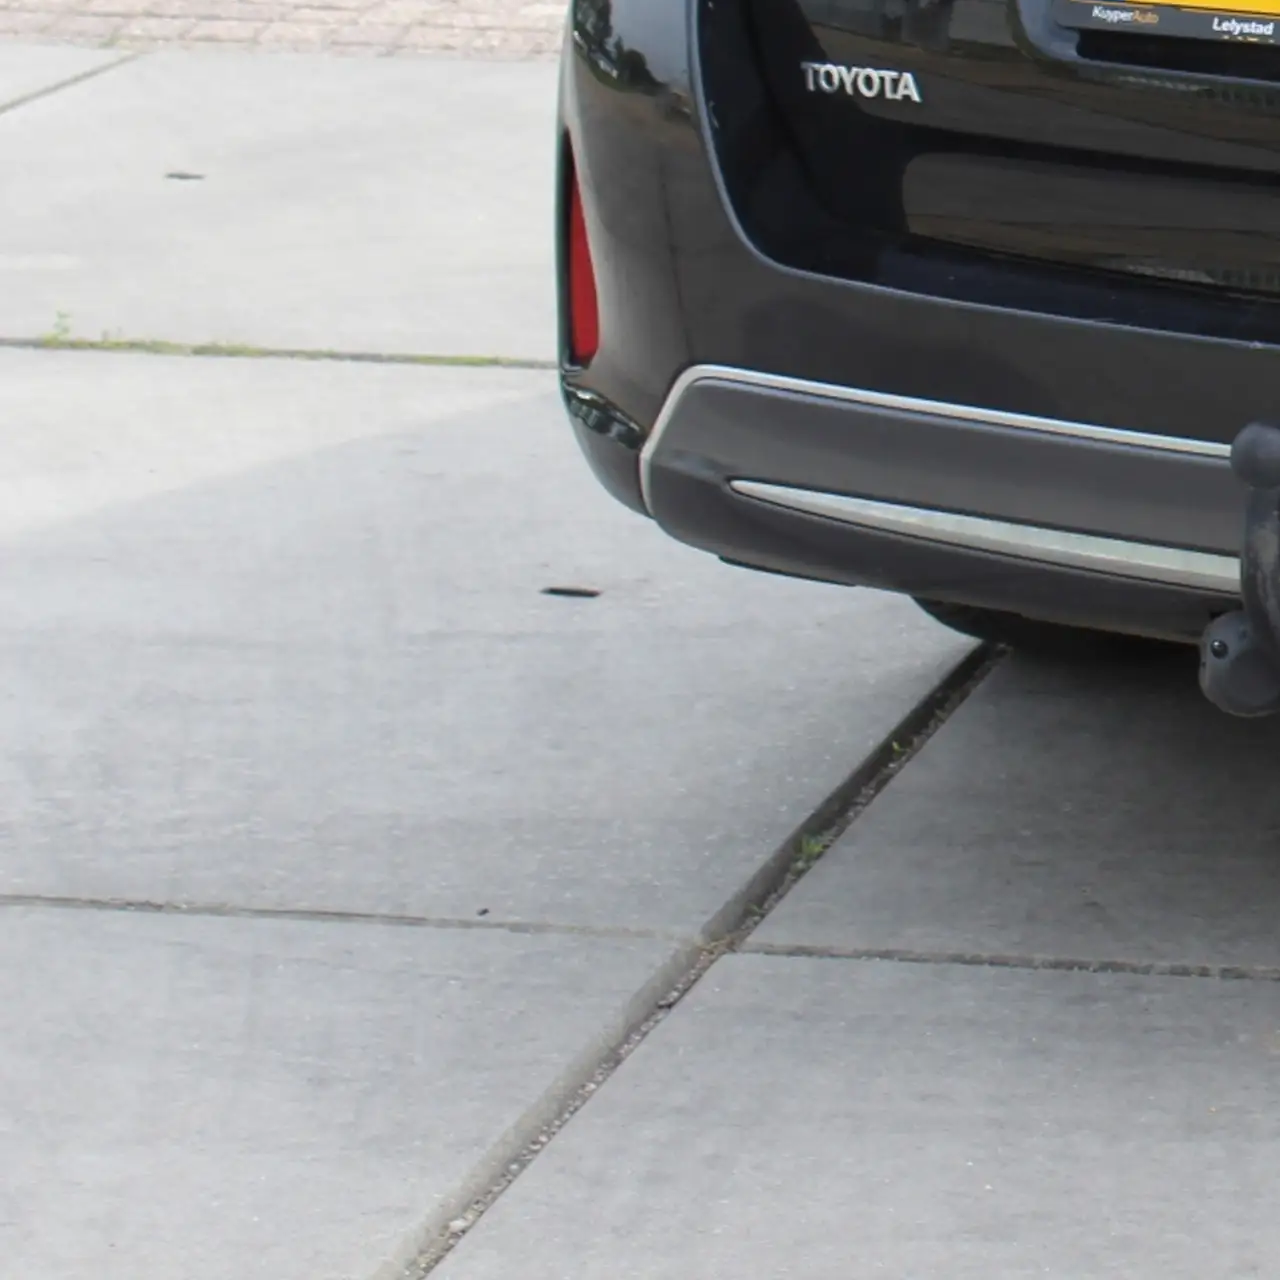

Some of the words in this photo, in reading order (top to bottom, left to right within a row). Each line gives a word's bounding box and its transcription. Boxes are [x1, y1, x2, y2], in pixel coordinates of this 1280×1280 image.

[1091, 4, 1160, 25] KuyperAuto
[1211, 16, 1275, 36] Lelystad
[800, 61, 922, 103] TOYOTA
